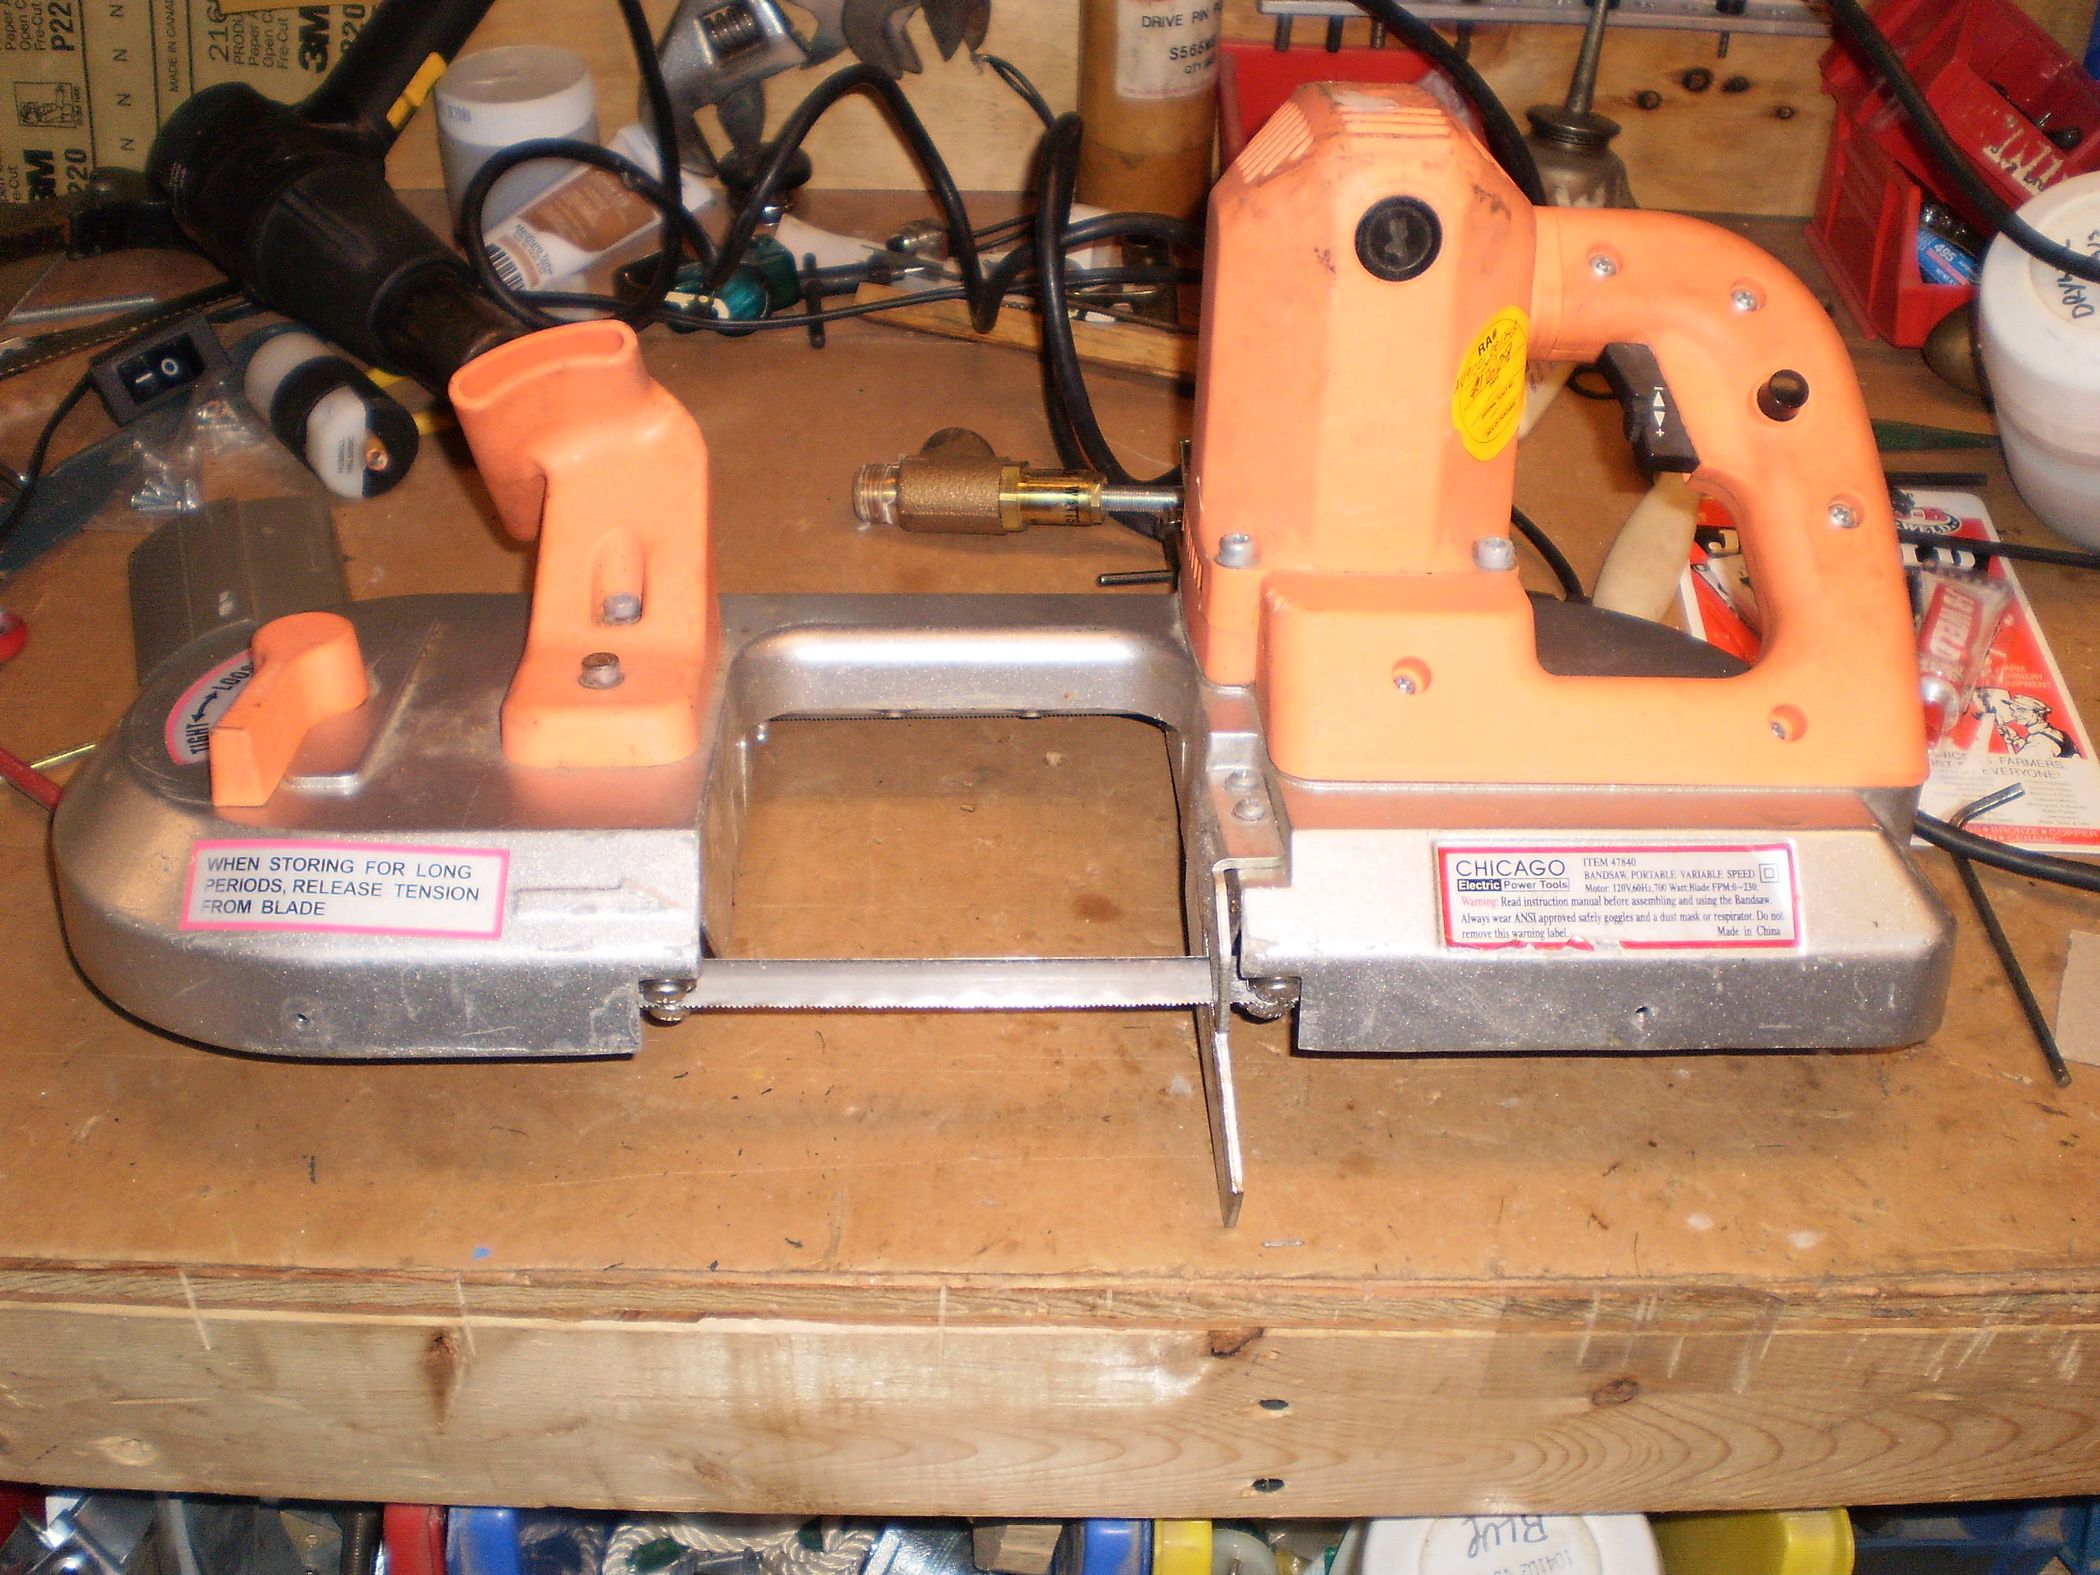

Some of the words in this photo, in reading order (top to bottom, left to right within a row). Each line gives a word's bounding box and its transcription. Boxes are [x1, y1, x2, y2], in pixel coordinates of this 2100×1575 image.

[1142, 14, 1184, 28] DRIVE
[298, 5, 331, 73] 3M
[167, 41, 177, 53] IN
[168, 57, 179, 92] MADE
[186, 723, 210, 754] TIGHT
[208, 857, 260, 872] WHEN
[269, 857, 354, 874] STORING
[365, 860, 405, 876] FOR
[416, 863, 472, 880] LONG
[1456, 860, 1566, 877] CHICAGO
[1583, 857, 1609, 867] ITEM
[1611, 857, 1637, 867] 47840
[1631, 870, 1677, 879] PORTABLE
[1680, 869, 1724, 879] VARIABLE
[1727, 869, 1756, 879] SPEED
[204, 878, 287, 895] PERIODS,
[292, 879, 383, 897] RELEASE
[394, 883, 480, 901] TENSION
[1458, 880, 1501, 890] Electric
[1503, 880, 1537, 890] Power
[1541, 880, 1568, 890] Tools
[201, 899, 252, 915] FROM
[261, 899, 326, 916] BLADE
[1501, 896, 1522, 907] Read
[1524, 896, 1569, 907] instruction
[1571, 896, 1602, 906] manual
[1604, 896, 1630, 906] before
[1632, 896, 1677, 908] assembling
[1679, 896, 1694, 906] and
[1696, 896, 1718, 907] using
[1720, 895, 1732, 905] the
[1461, 913, 1490, 925] Always
[1492, 915, 1511, 923] wear
[1514, 913, 1537, 923] ANSI
[1539, 913, 1576, 925] approved
[1604, 912, 1633, 924] goggles
[1636, 912, 1651, 922] and
[1660, 912, 1678, 921] dust
[1680, 911, 1701, 921] mask
[1756, 910, 1769, 920] Do
[1771, 911, 1784, 920] not
[1462, 931, 1492, 939] remove
[1494, 928, 1510, 939] this
[1512, 929, 1545, 942] warning
[1718, 926, 1739, 936] Made
[1744, 926, 1753, 936] in
